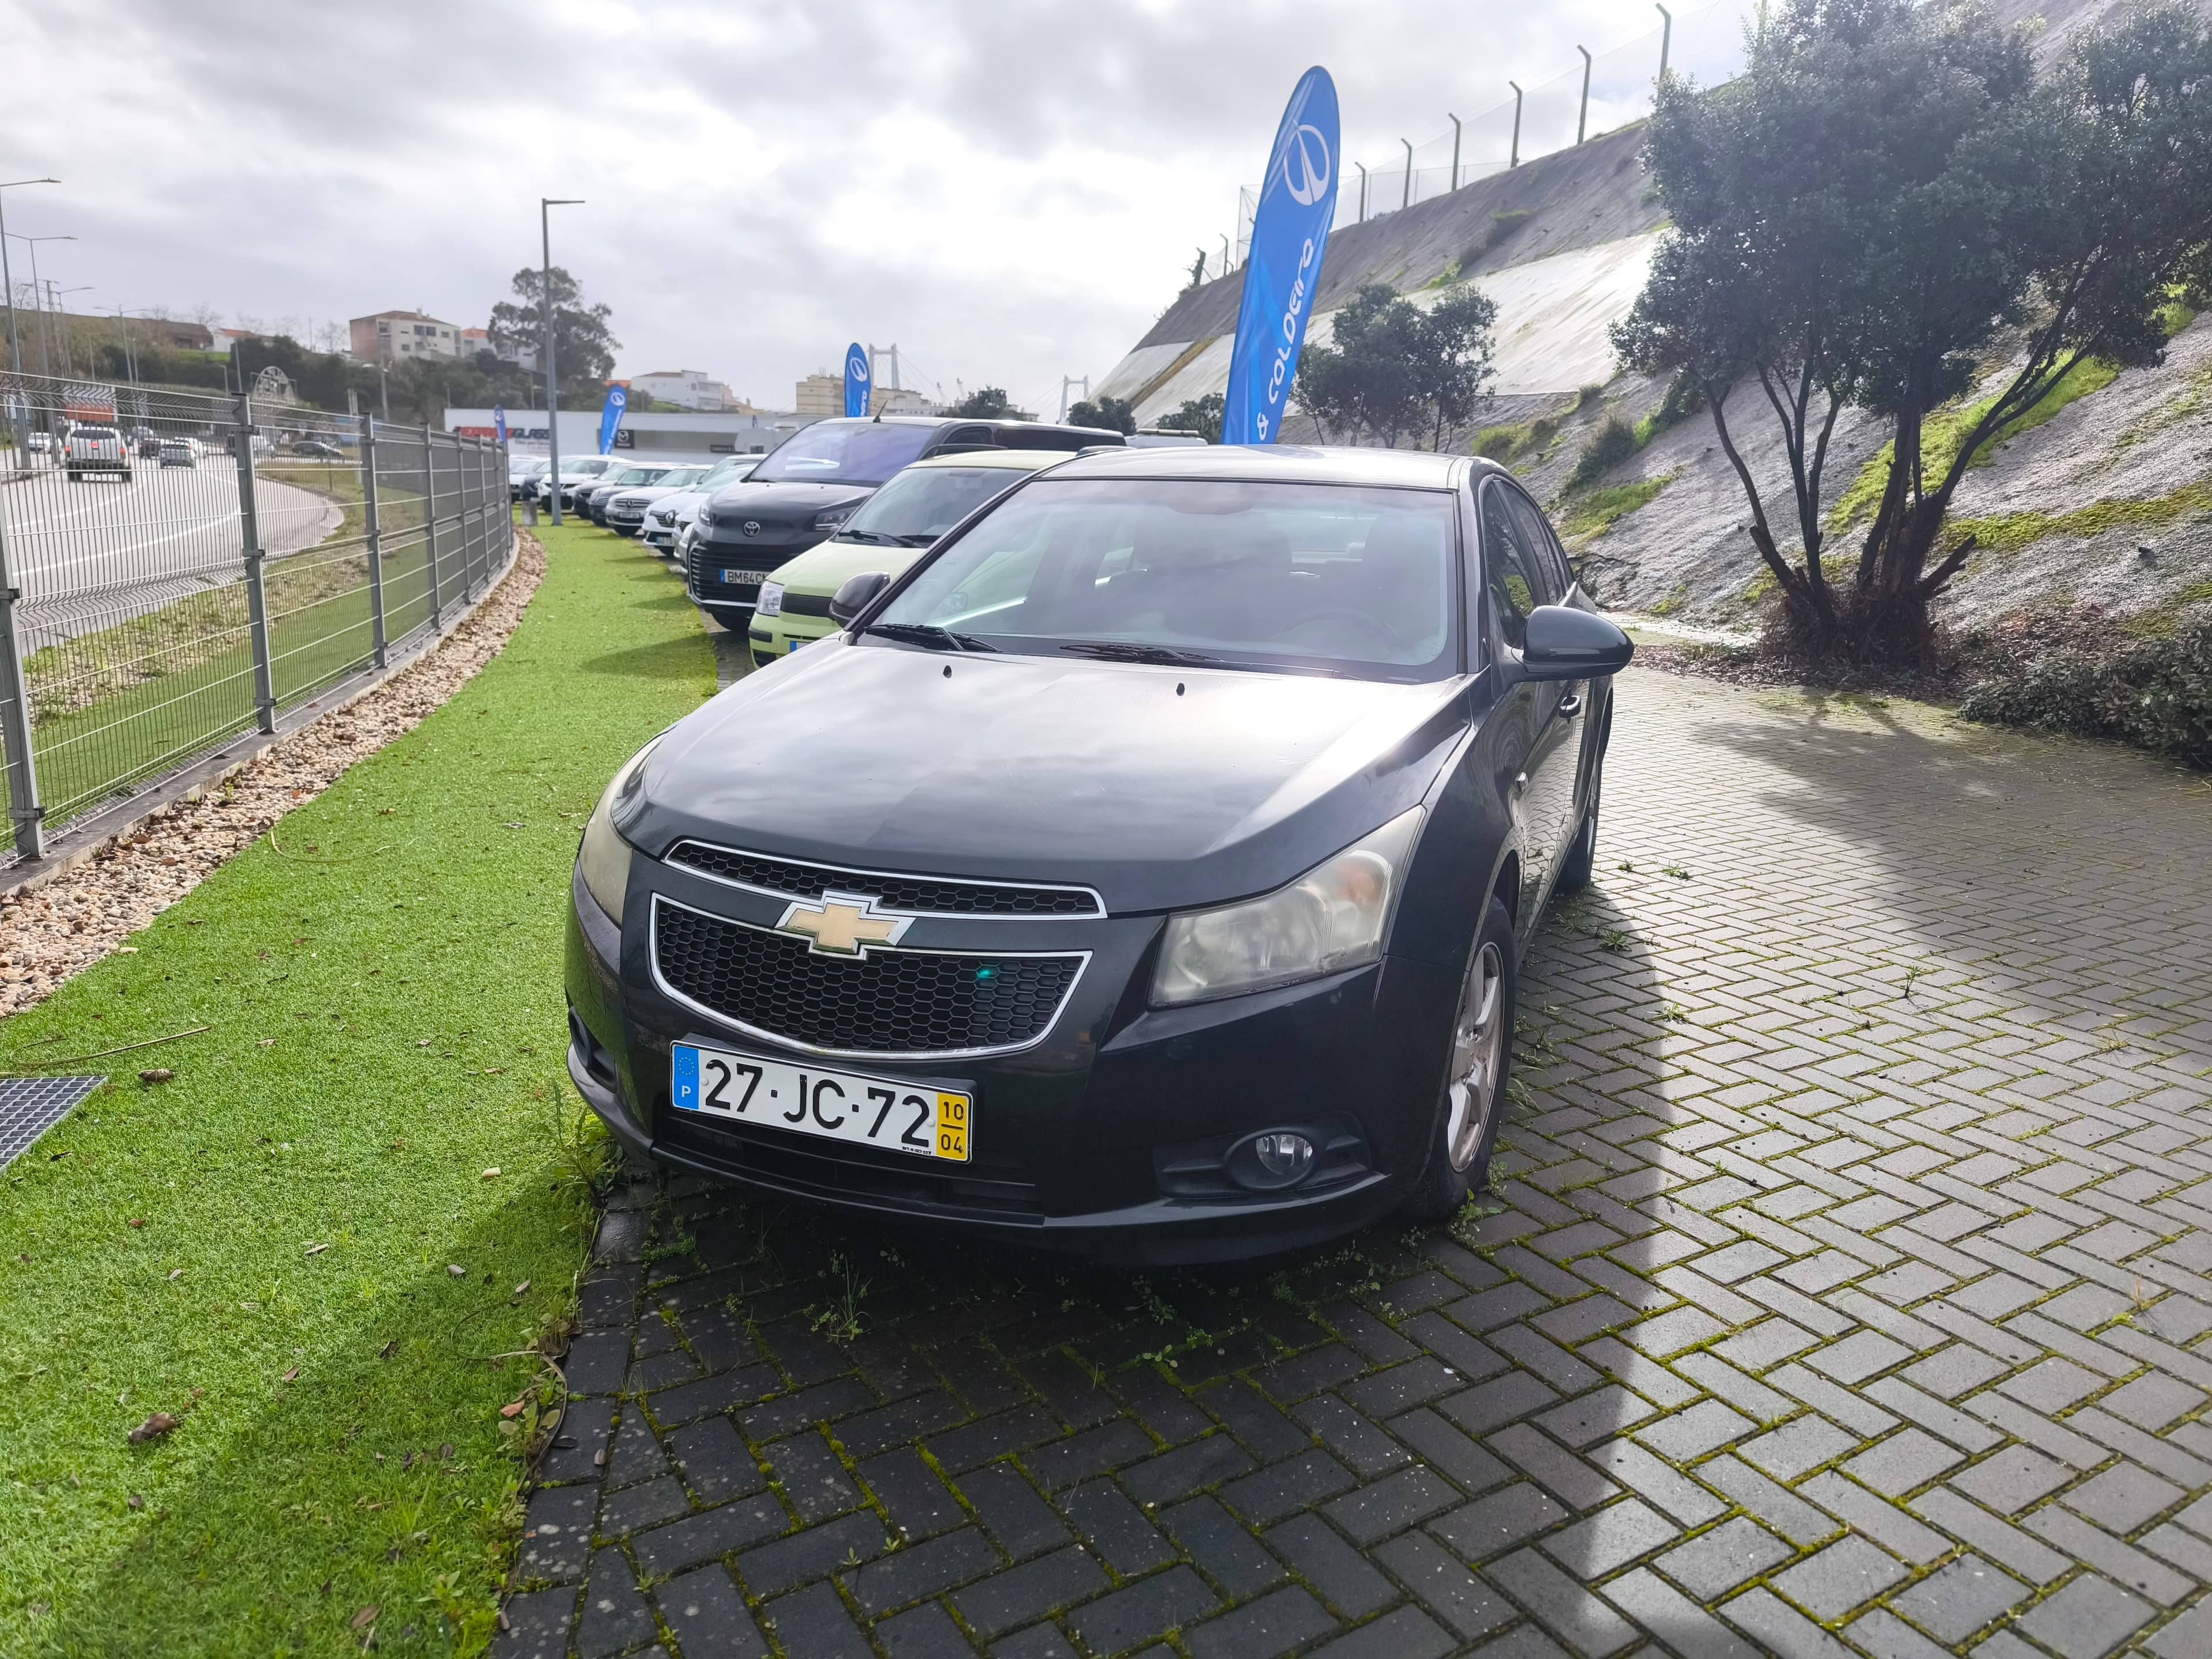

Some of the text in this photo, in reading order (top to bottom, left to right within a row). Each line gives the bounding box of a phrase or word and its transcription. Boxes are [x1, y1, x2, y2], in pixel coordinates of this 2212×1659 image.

[681, 1085, 691, 1098] P
[943, 1101, 964, 1120] 10
[941, 1134, 964, 1153] 04
